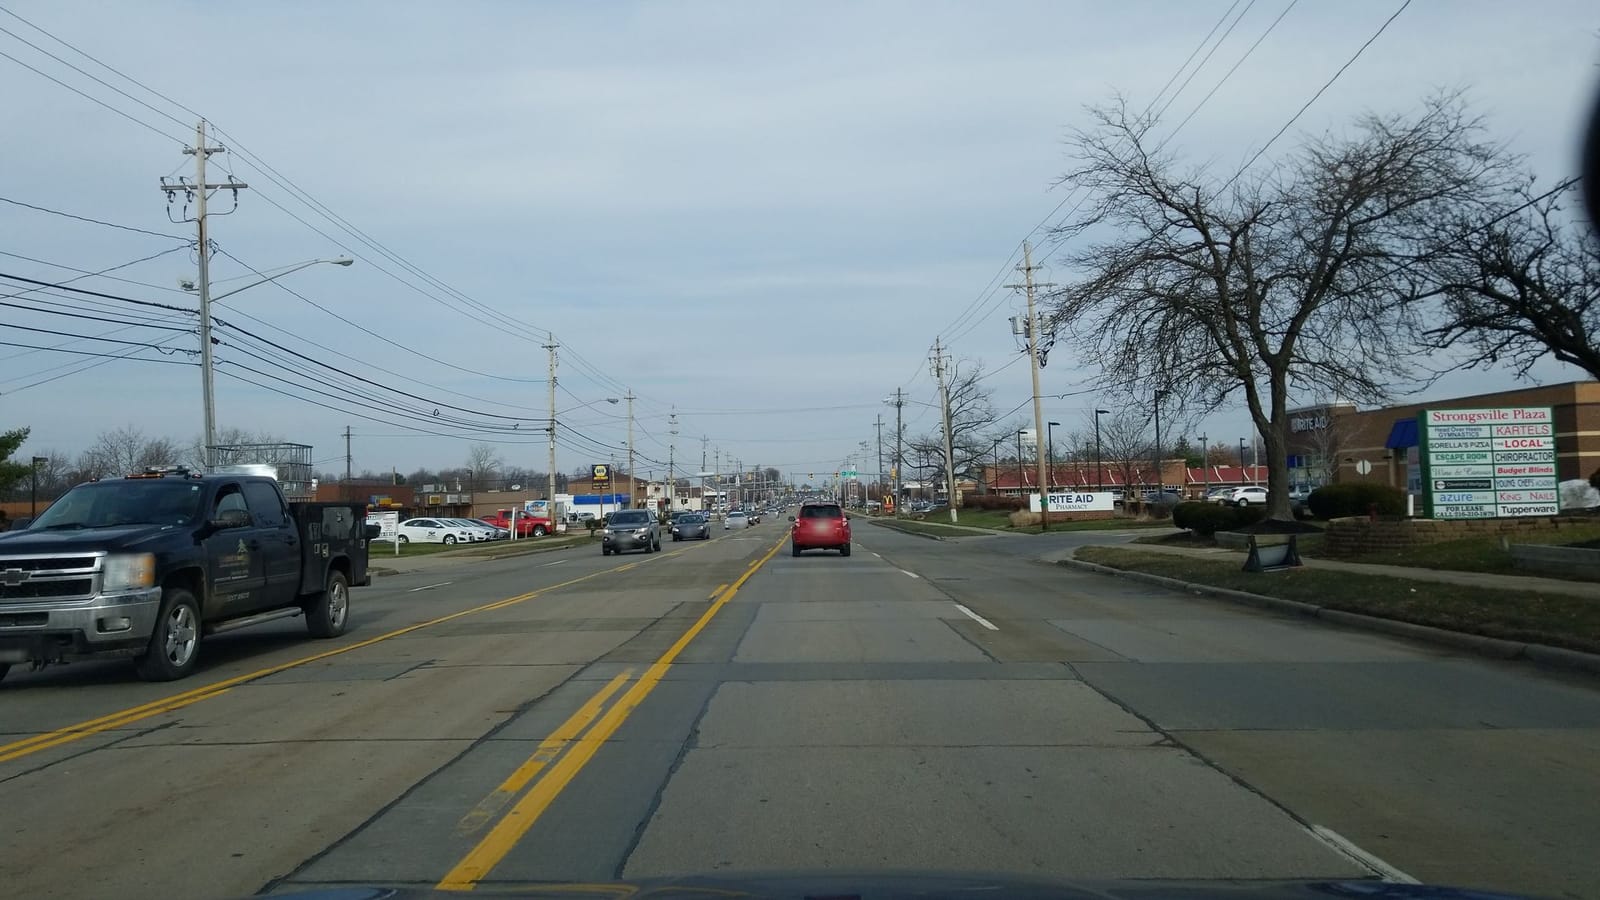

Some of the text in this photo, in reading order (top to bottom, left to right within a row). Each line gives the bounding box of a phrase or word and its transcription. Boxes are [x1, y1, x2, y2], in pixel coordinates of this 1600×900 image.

[1433, 409, 1546, 423] Strongsville Plaza
[1496, 425, 1550, 436] KARTELS
[1504, 439, 1544, 448] LOCAL
[1494, 452, 1553, 462] CHIROPRACTOR
[1049, 495, 1094, 503] RITE AID
[1440, 493, 1473, 502] azure
[1501, 505, 1556, 514] Tupperware
